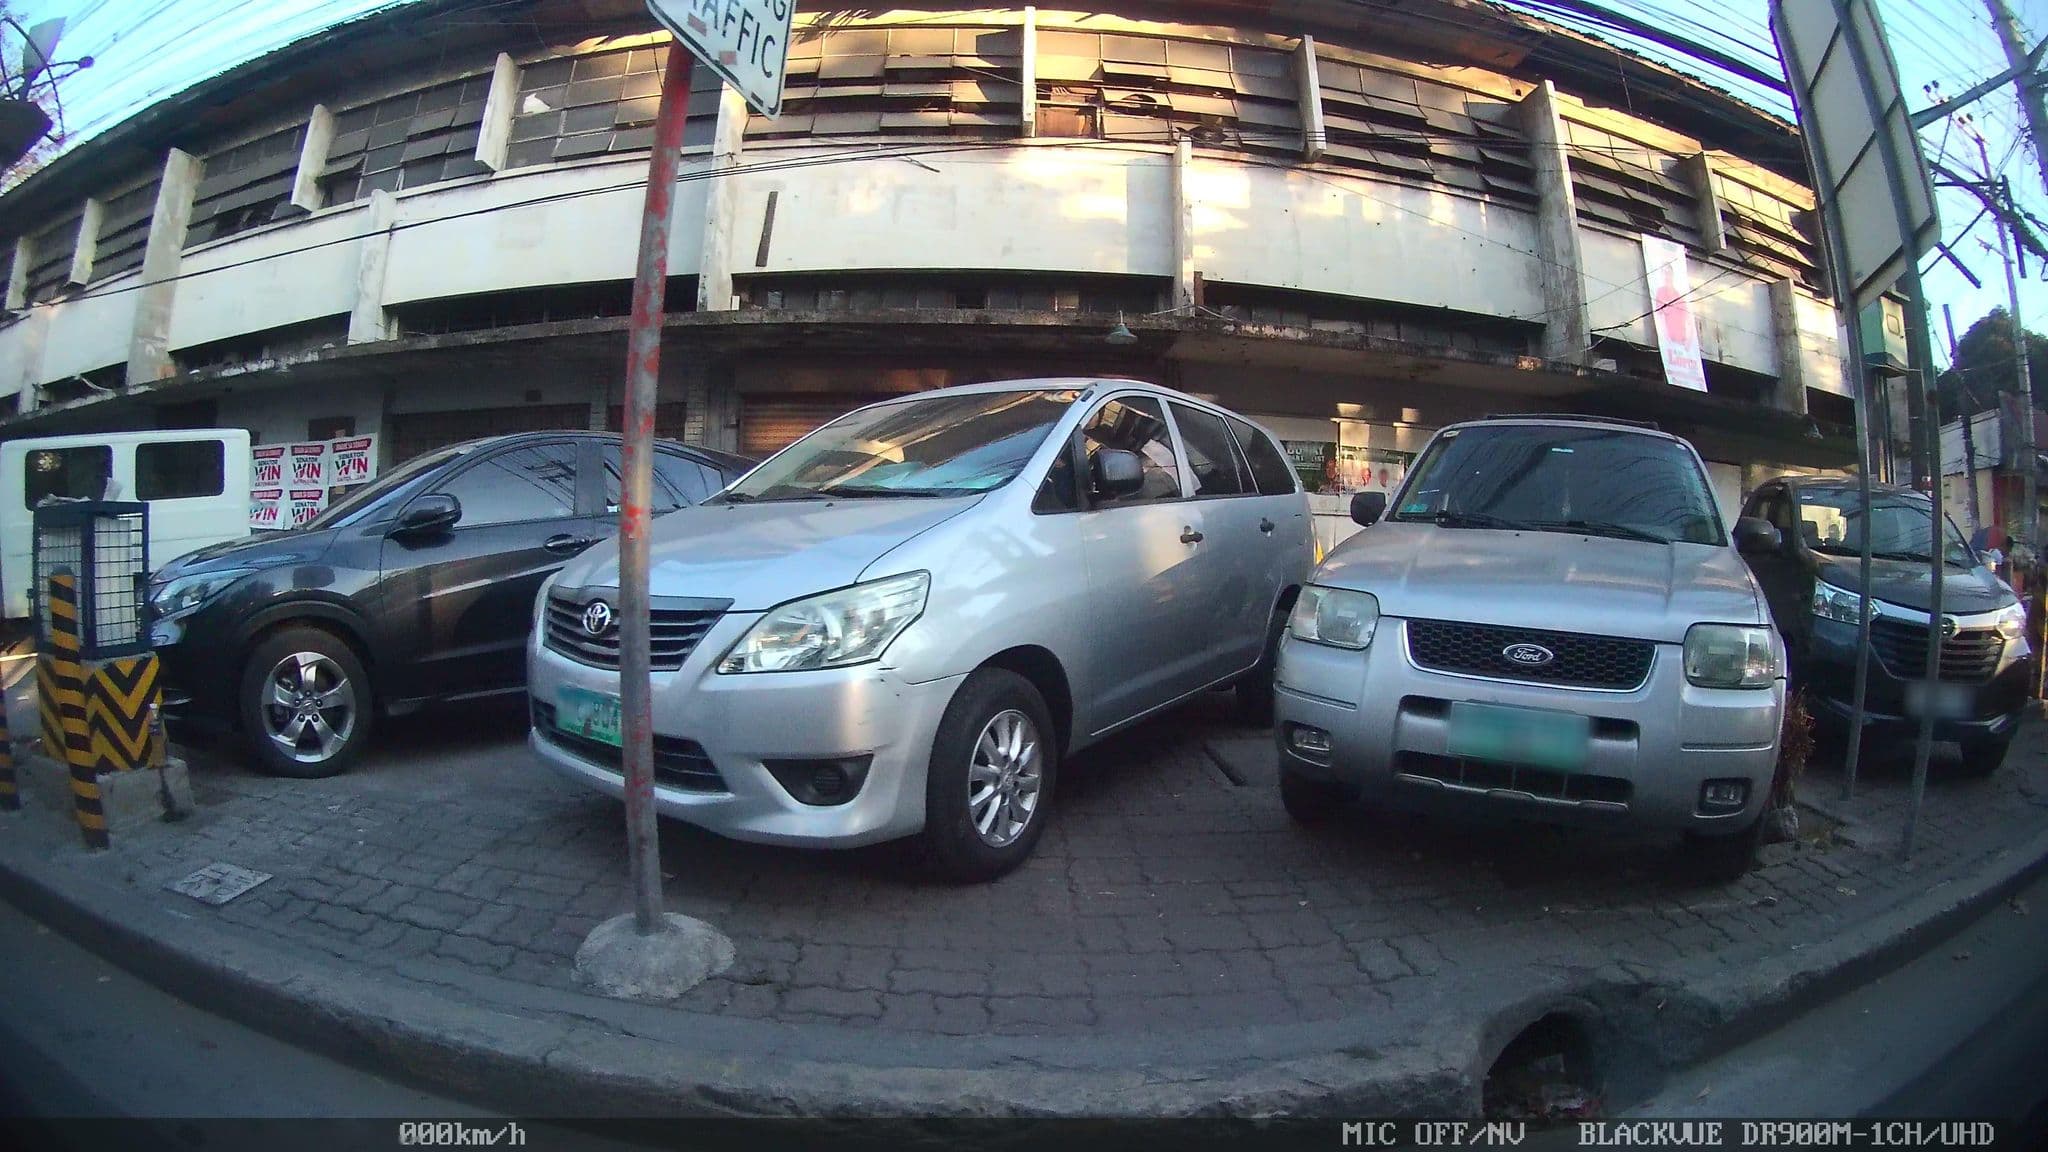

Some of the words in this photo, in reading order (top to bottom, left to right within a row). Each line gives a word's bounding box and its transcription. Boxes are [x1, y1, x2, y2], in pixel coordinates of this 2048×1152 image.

[255, 465, 281, 480] WIN
[292, 463, 321, 478] WIN
[335, 457, 368, 475] WIN
[1513, 647, 1543, 661] Ford
